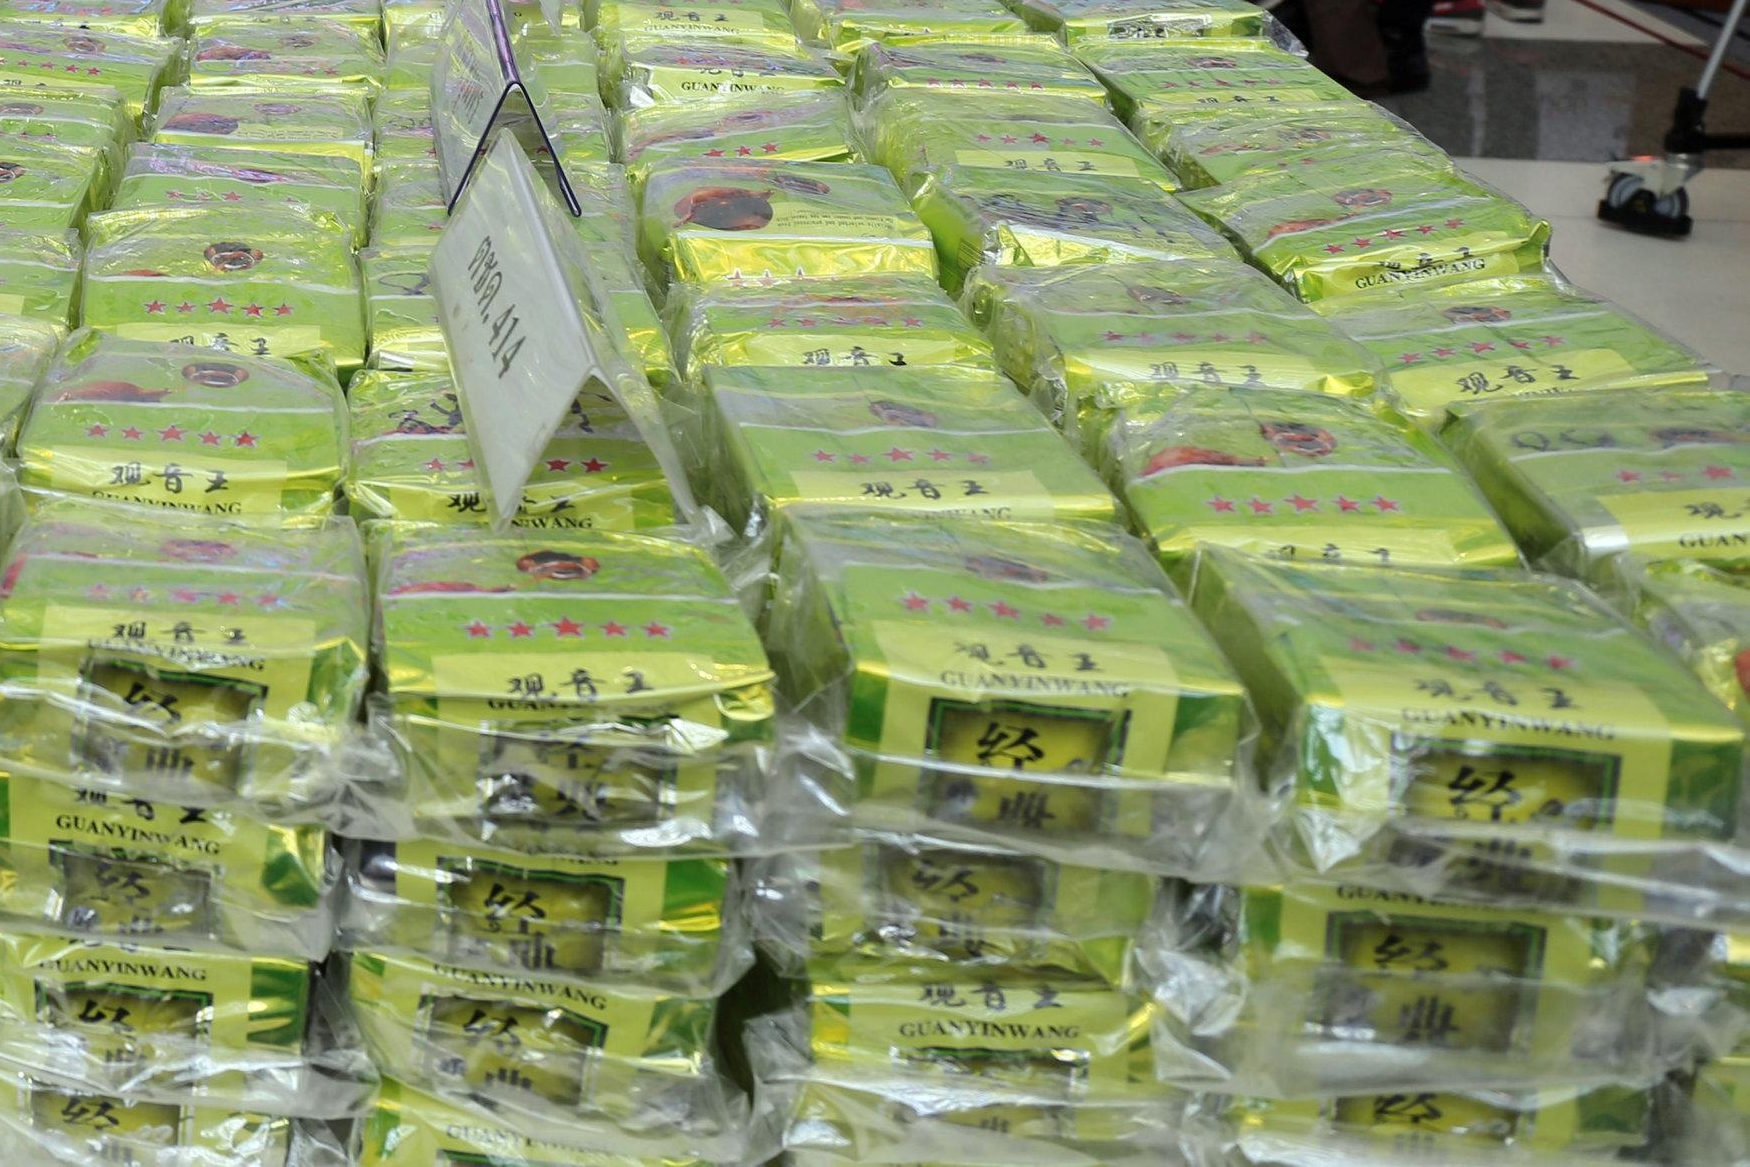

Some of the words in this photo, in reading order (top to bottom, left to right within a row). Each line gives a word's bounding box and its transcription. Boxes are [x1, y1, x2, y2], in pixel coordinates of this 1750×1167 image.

[488, 304, 527, 380] 414
[110, 462, 229, 494] 观音王
[940, 670, 1129, 698] GUANYINWANG
[55, 814, 221, 855] GUANYINWANG
[899, 1020, 1080, 1040] GUANYINWANG
